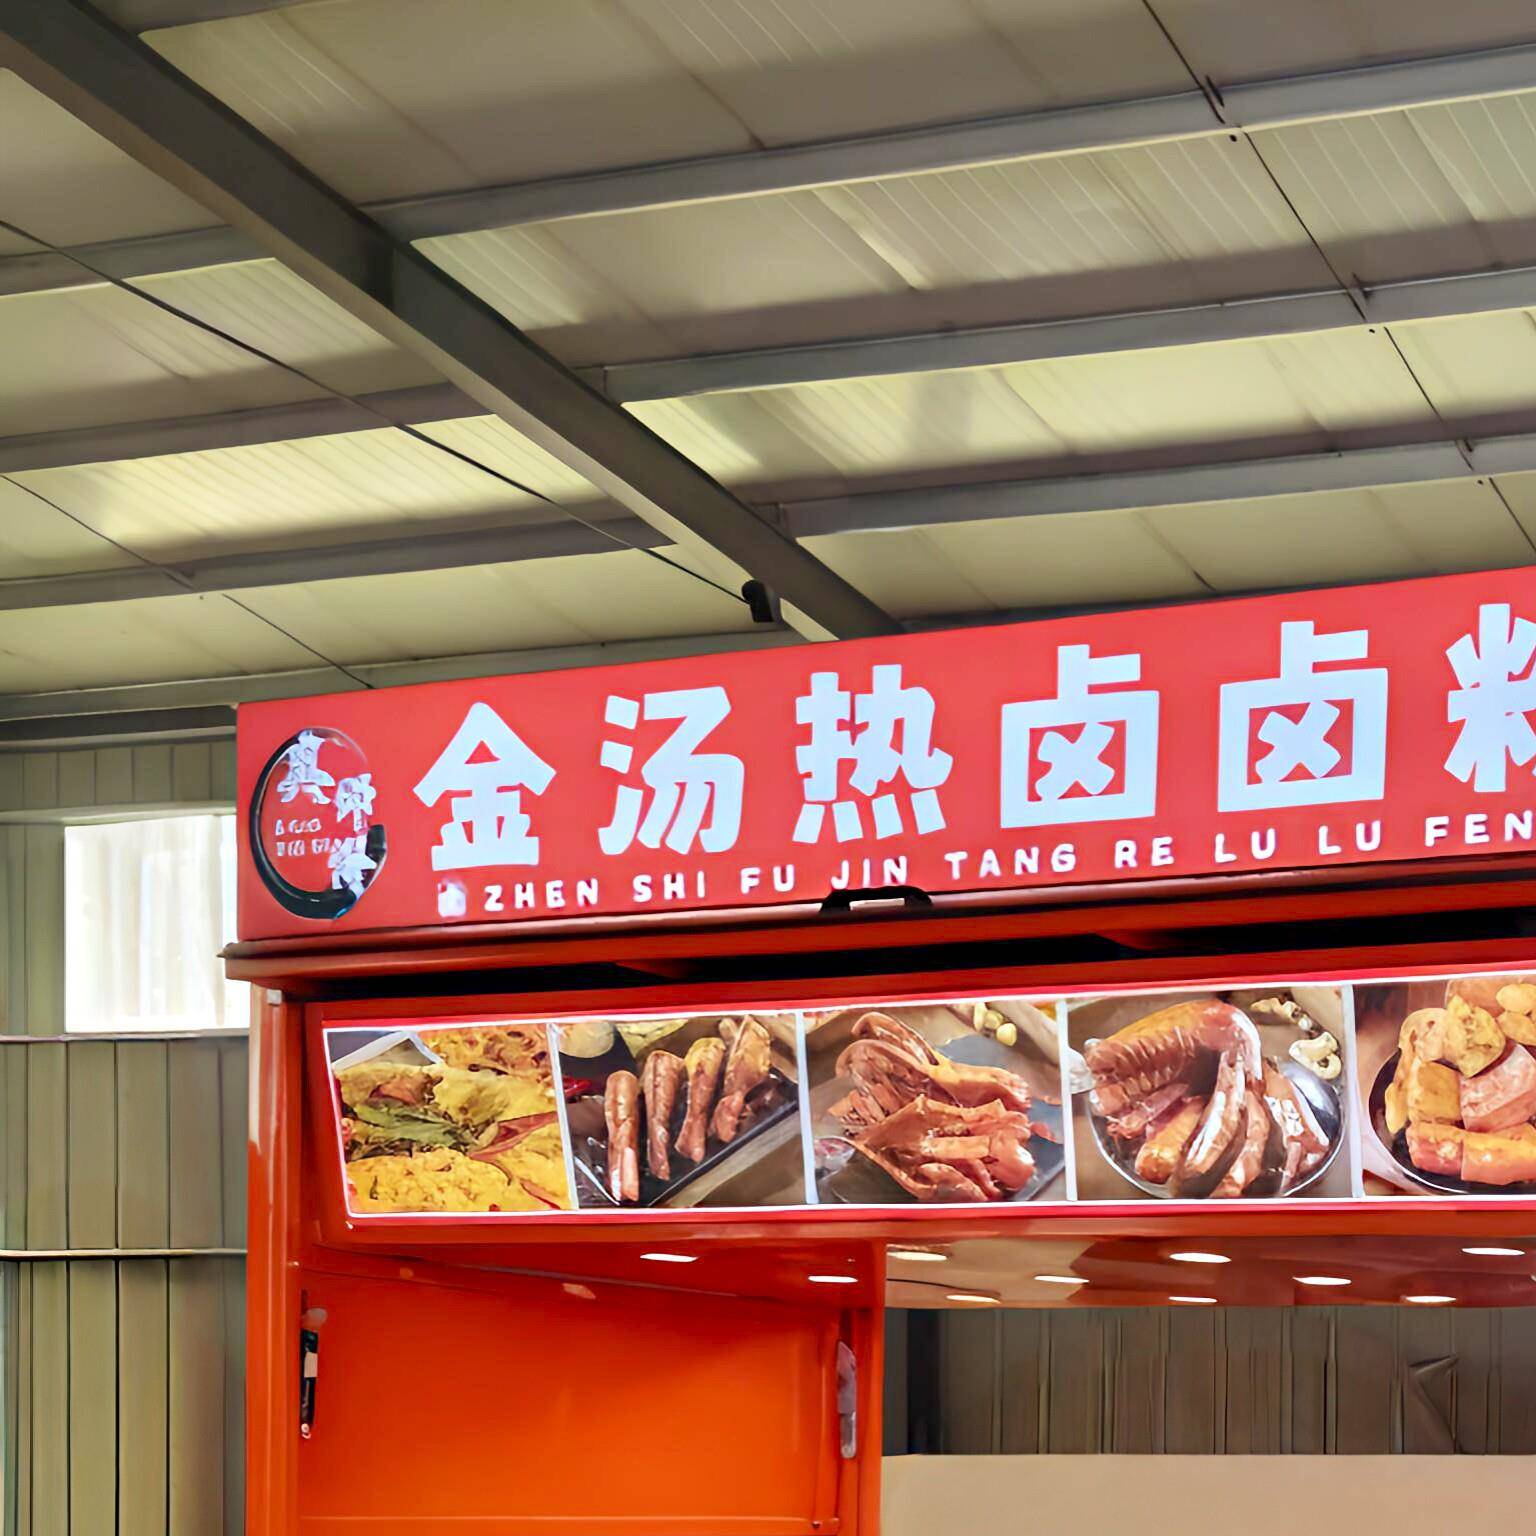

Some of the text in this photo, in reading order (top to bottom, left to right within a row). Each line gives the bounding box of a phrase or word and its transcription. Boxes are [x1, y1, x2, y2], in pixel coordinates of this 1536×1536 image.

[484, 878, 598, 912] ZHEN
[632, 870, 705, 903] SHI
[740, 864, 795, 894] FU
[830, 855, 907, 888] JIN
[944, 843, 1076, 880] TANG
[1114, 836, 1174, 869] RE
[1214, 828, 1276, 863] LU
[1318, 820, 1381, 855] LU
[1425, 810, 1533, 847] FEN
